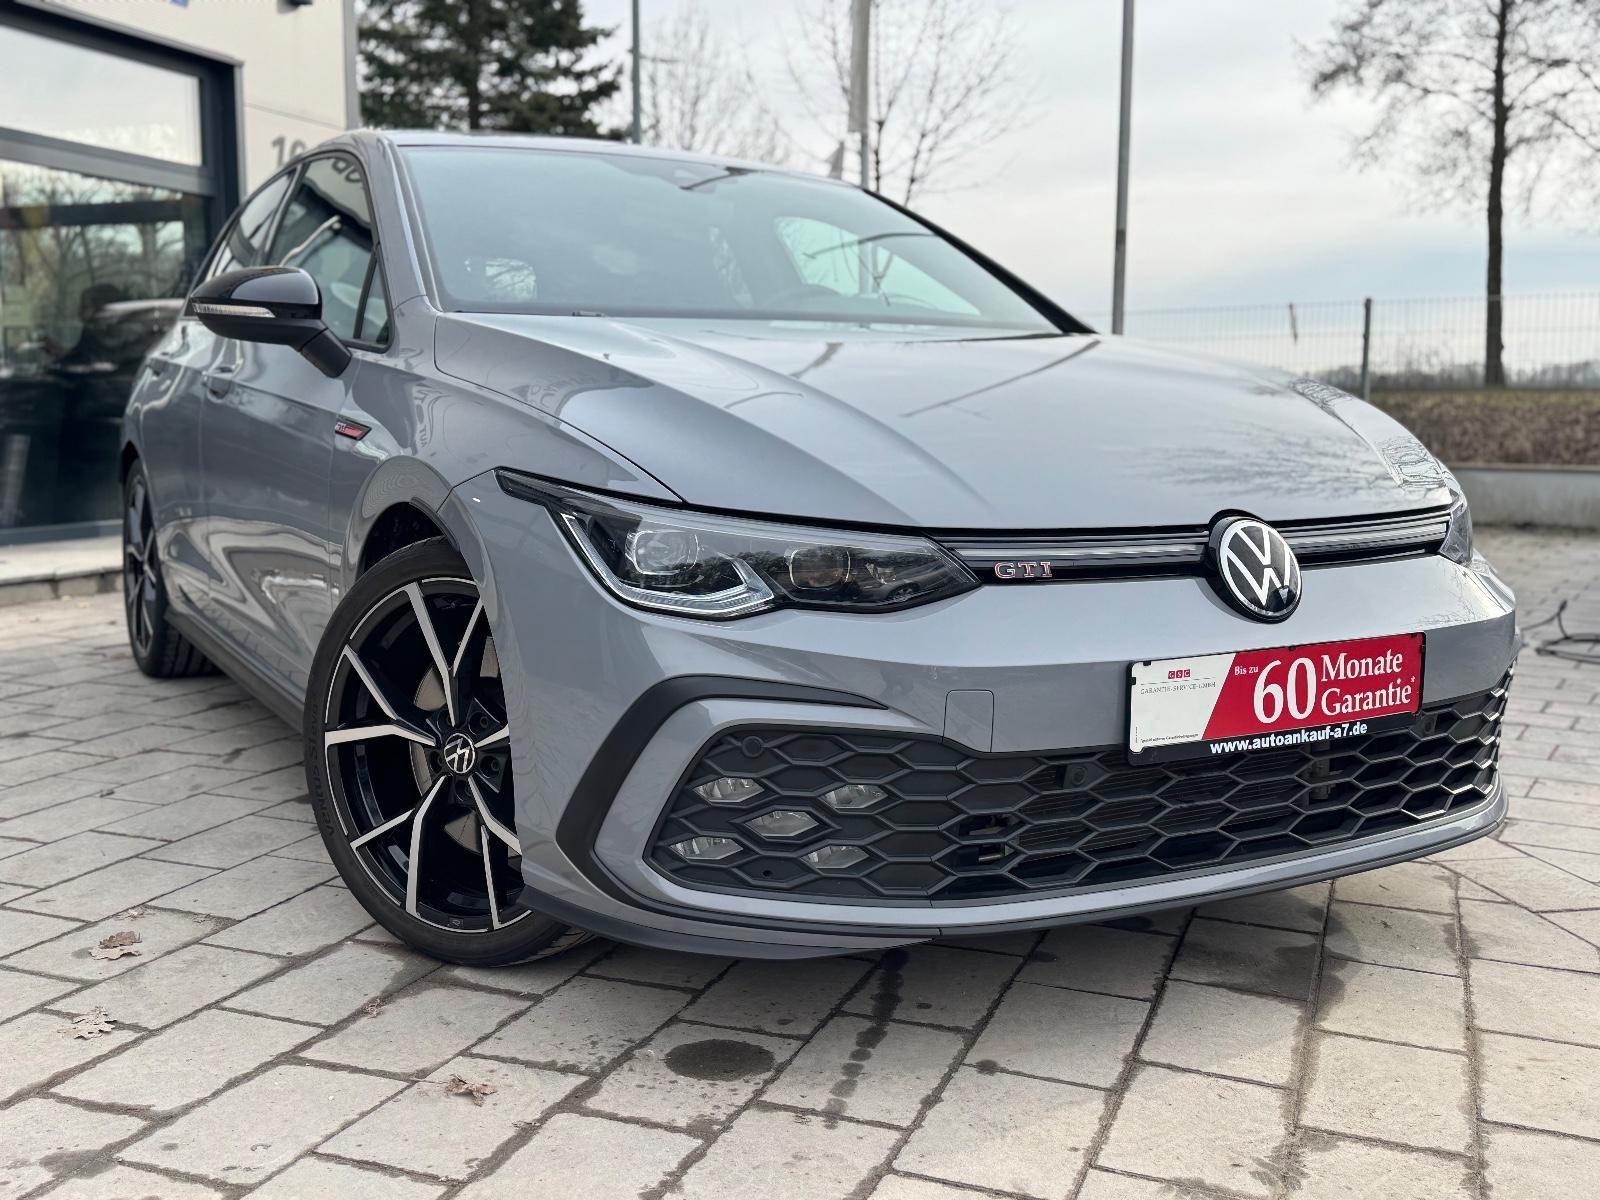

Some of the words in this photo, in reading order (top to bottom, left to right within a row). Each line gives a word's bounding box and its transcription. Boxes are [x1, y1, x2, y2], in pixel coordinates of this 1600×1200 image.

[994, 561, 1053, 579] GTI
[1234, 665, 1247, 676] Bis
[1248, 665, 1259, 675] zu
[1321, 648, 1404, 682] Monate
[1253, 657, 1317, 724] 60
[1210, 721, 1368, 755] www.autoankauf-a7.de
